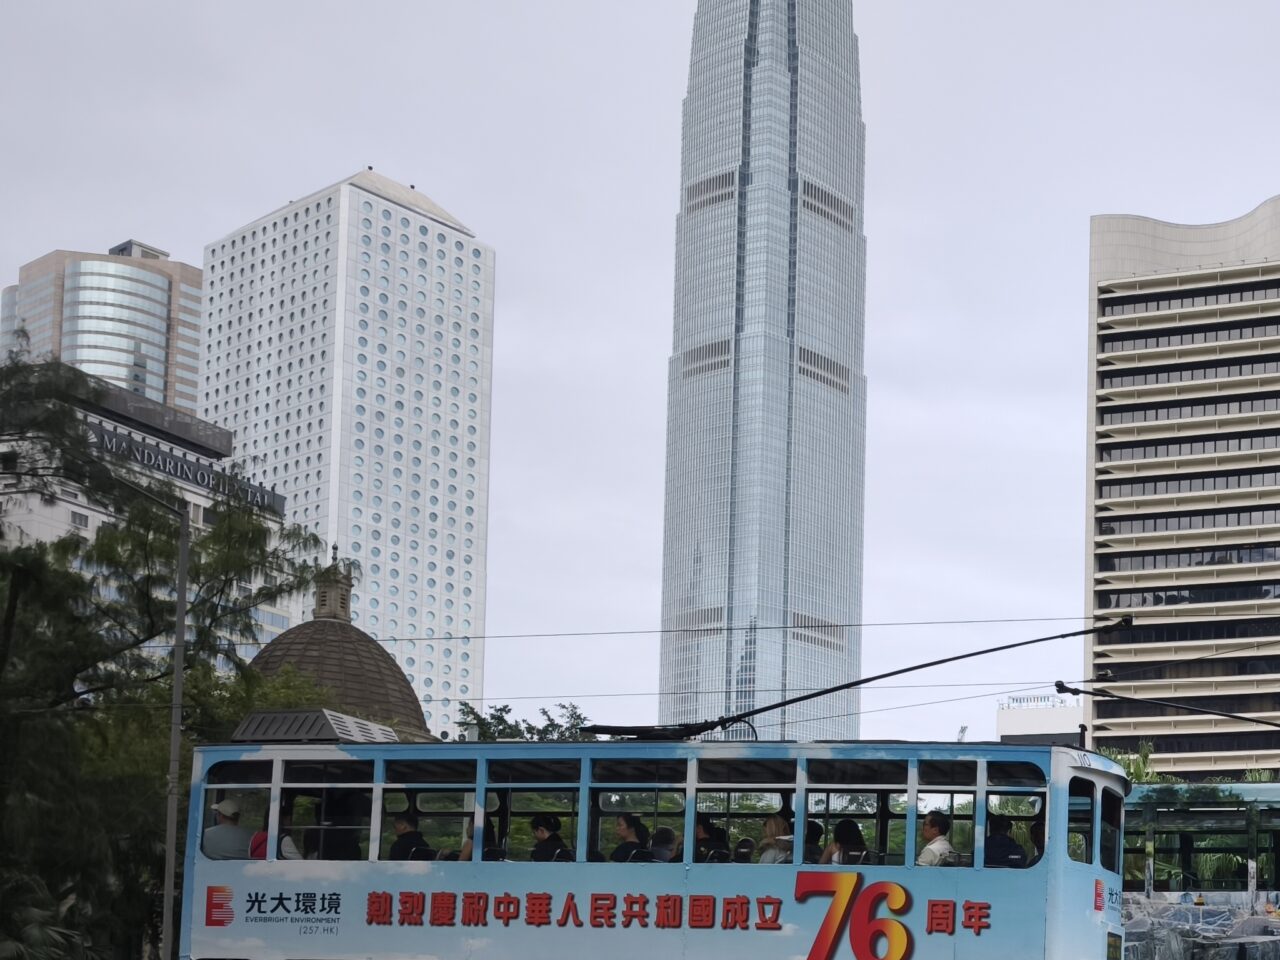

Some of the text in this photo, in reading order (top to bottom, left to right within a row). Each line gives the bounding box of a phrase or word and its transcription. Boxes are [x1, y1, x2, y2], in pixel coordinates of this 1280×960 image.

[103, 434, 193, 480] MANDARIN
[246, 892, 342, 915] 光大環境
[366, 891, 783, 930] 熱烈慶祝中華人民共和國成立
[926, 899, 991, 936] 周年
